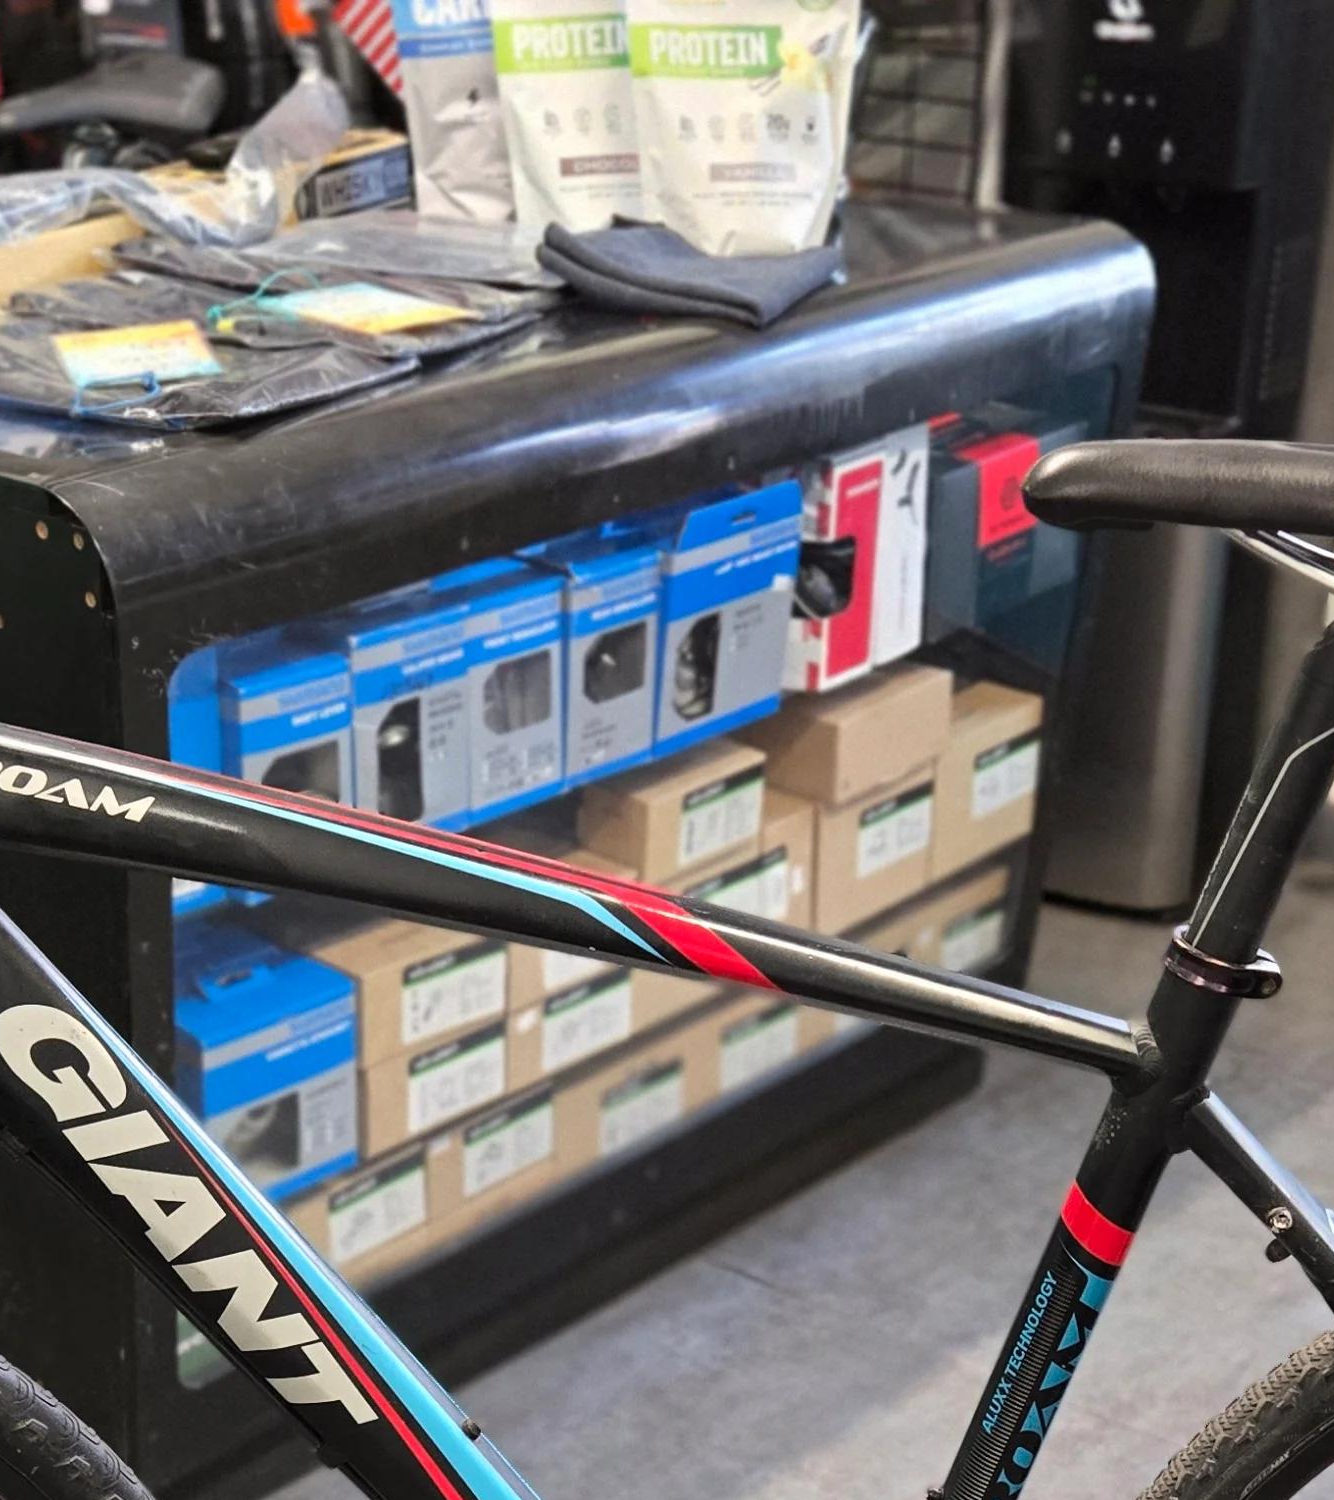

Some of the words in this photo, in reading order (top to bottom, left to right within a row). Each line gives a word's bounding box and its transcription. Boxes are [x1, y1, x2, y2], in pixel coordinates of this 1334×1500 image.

[649, 29, 768, 66] PROTEIN
[982, 1377, 1013, 1434] ALUXX
[1005, 1271, 1058, 1378] TECHNOLOGY
